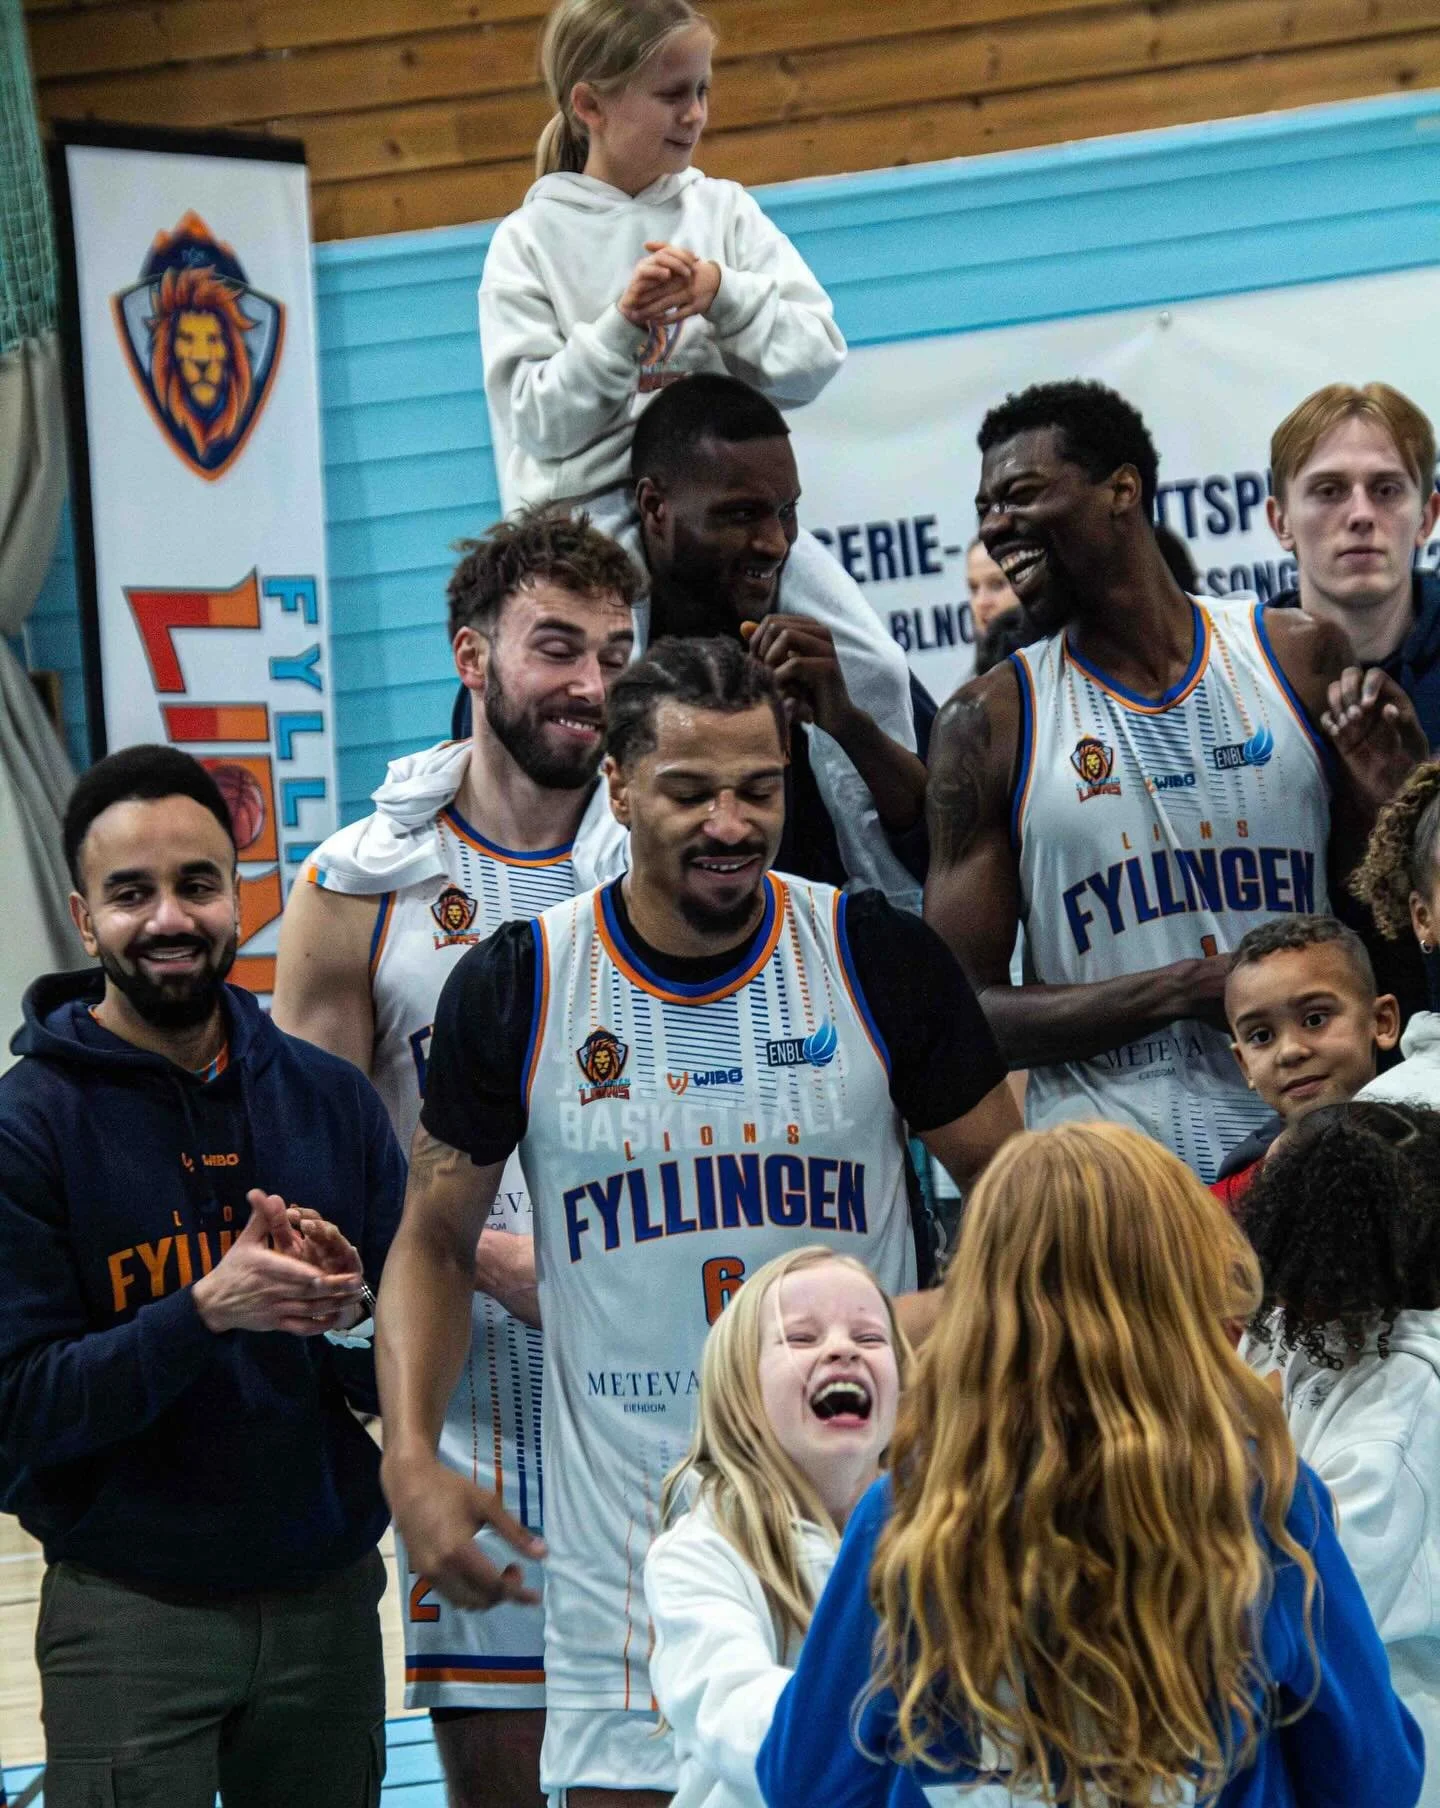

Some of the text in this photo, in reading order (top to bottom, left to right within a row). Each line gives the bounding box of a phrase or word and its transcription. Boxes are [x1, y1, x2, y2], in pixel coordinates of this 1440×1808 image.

[1155, 468, 1272, 541] TTSP
[810, 514, 962, 583] ERIE-
[263, 574, 326, 896] FYLLI
[1215, 747, 1246, 769] ENBL
[1121, 819, 1249, 850] LINS
[1062, 846, 1314, 957] FYLLINGEN
[768, 1041, 805, 1066] ENBL
[694, 1066, 743, 1087] WIBO
[202, 1153, 240, 1167] WIBO
[624, 1120, 800, 1161] LIONS
[562, 1152, 868, 1264] FYLLINGEN
[702, 1256, 746, 1327] 6
[587, 1370, 700, 1397] METEVA
